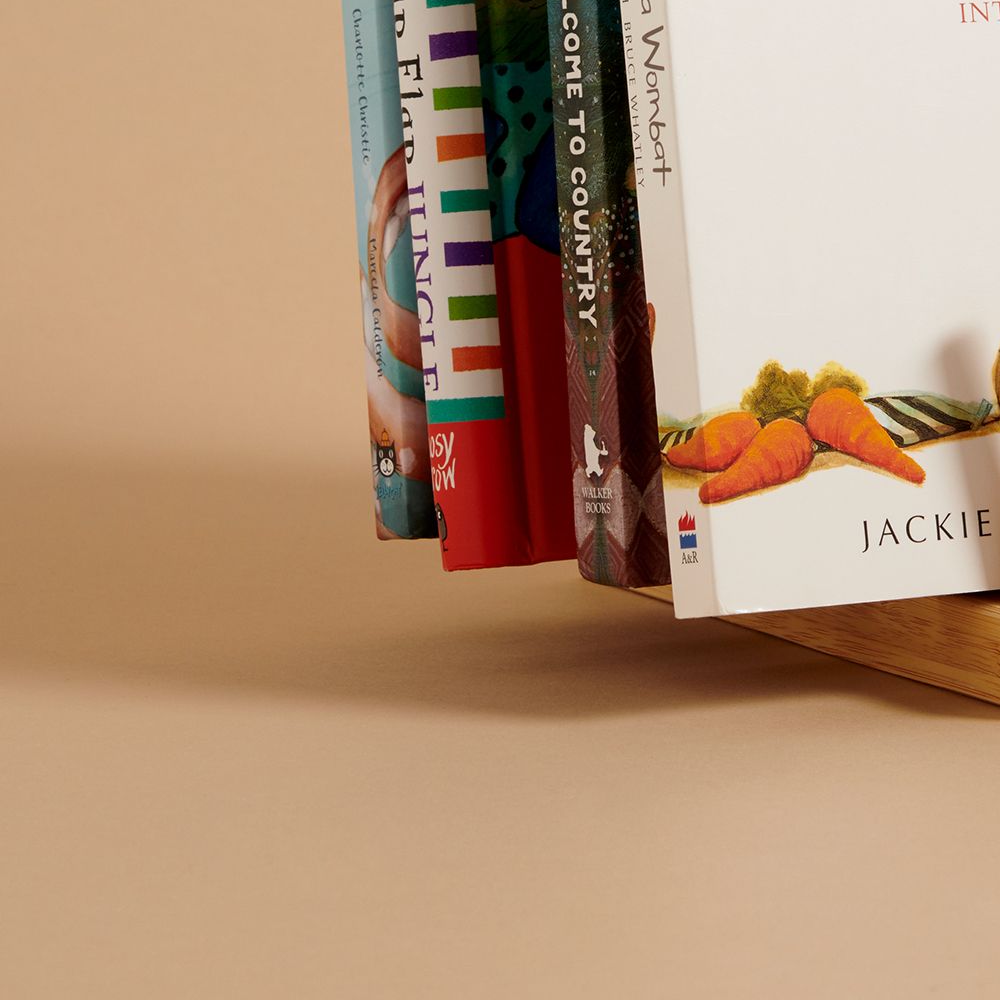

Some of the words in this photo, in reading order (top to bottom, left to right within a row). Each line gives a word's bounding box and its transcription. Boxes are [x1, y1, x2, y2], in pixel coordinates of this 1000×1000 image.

[352, 8, 366, 91] Charlotte
[358, 95, 371, 165] Christie
[568, 110, 586, 155] TO
[624, 22, 637, 85] BRUCE
[631, 95, 645, 188] WHATLEY
[642, 25, 672, 187] Wombat
[369, 238, 380, 304] Marcela
[571, 167, 597, 329] COUNTRY
[581, 487, 613, 499] WALKER
[585, 502, 611, 514] BOOKS
[682, 551, 699, 564] A&R
[862, 509, 992, 553] JACKIE
